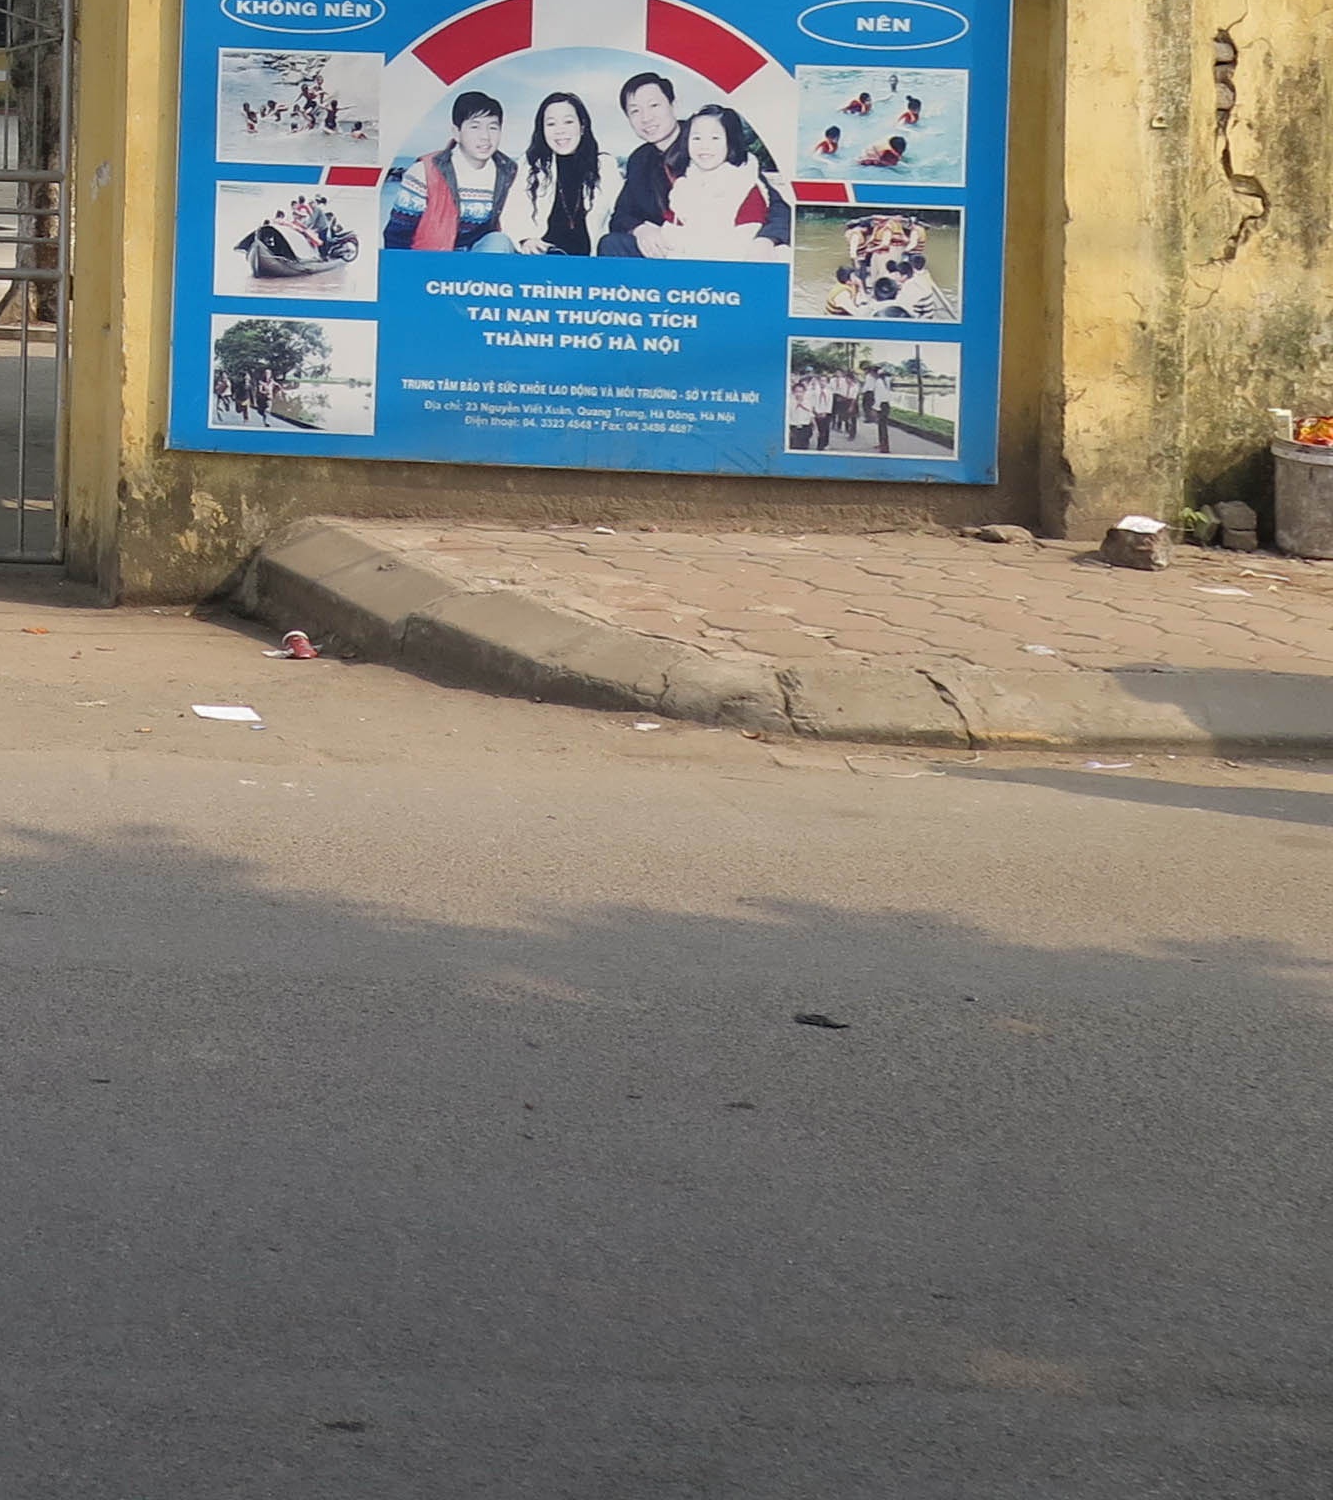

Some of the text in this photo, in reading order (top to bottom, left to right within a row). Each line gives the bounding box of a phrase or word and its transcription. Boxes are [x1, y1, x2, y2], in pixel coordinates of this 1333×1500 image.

[324, 0, 372, 18] NÊN
[855, 14, 911, 32] NÊN
[425, 280, 741, 306] CHƯƠNG TRÌNH PHÒNG CHỐNG
[466, 306, 698, 329] TAI NẠN THƯƠNG TÍCH
[482, 330, 681, 356] THÀNH PHỐ HÀ NỘI
[401, 379, 435, 391] TRUNG
